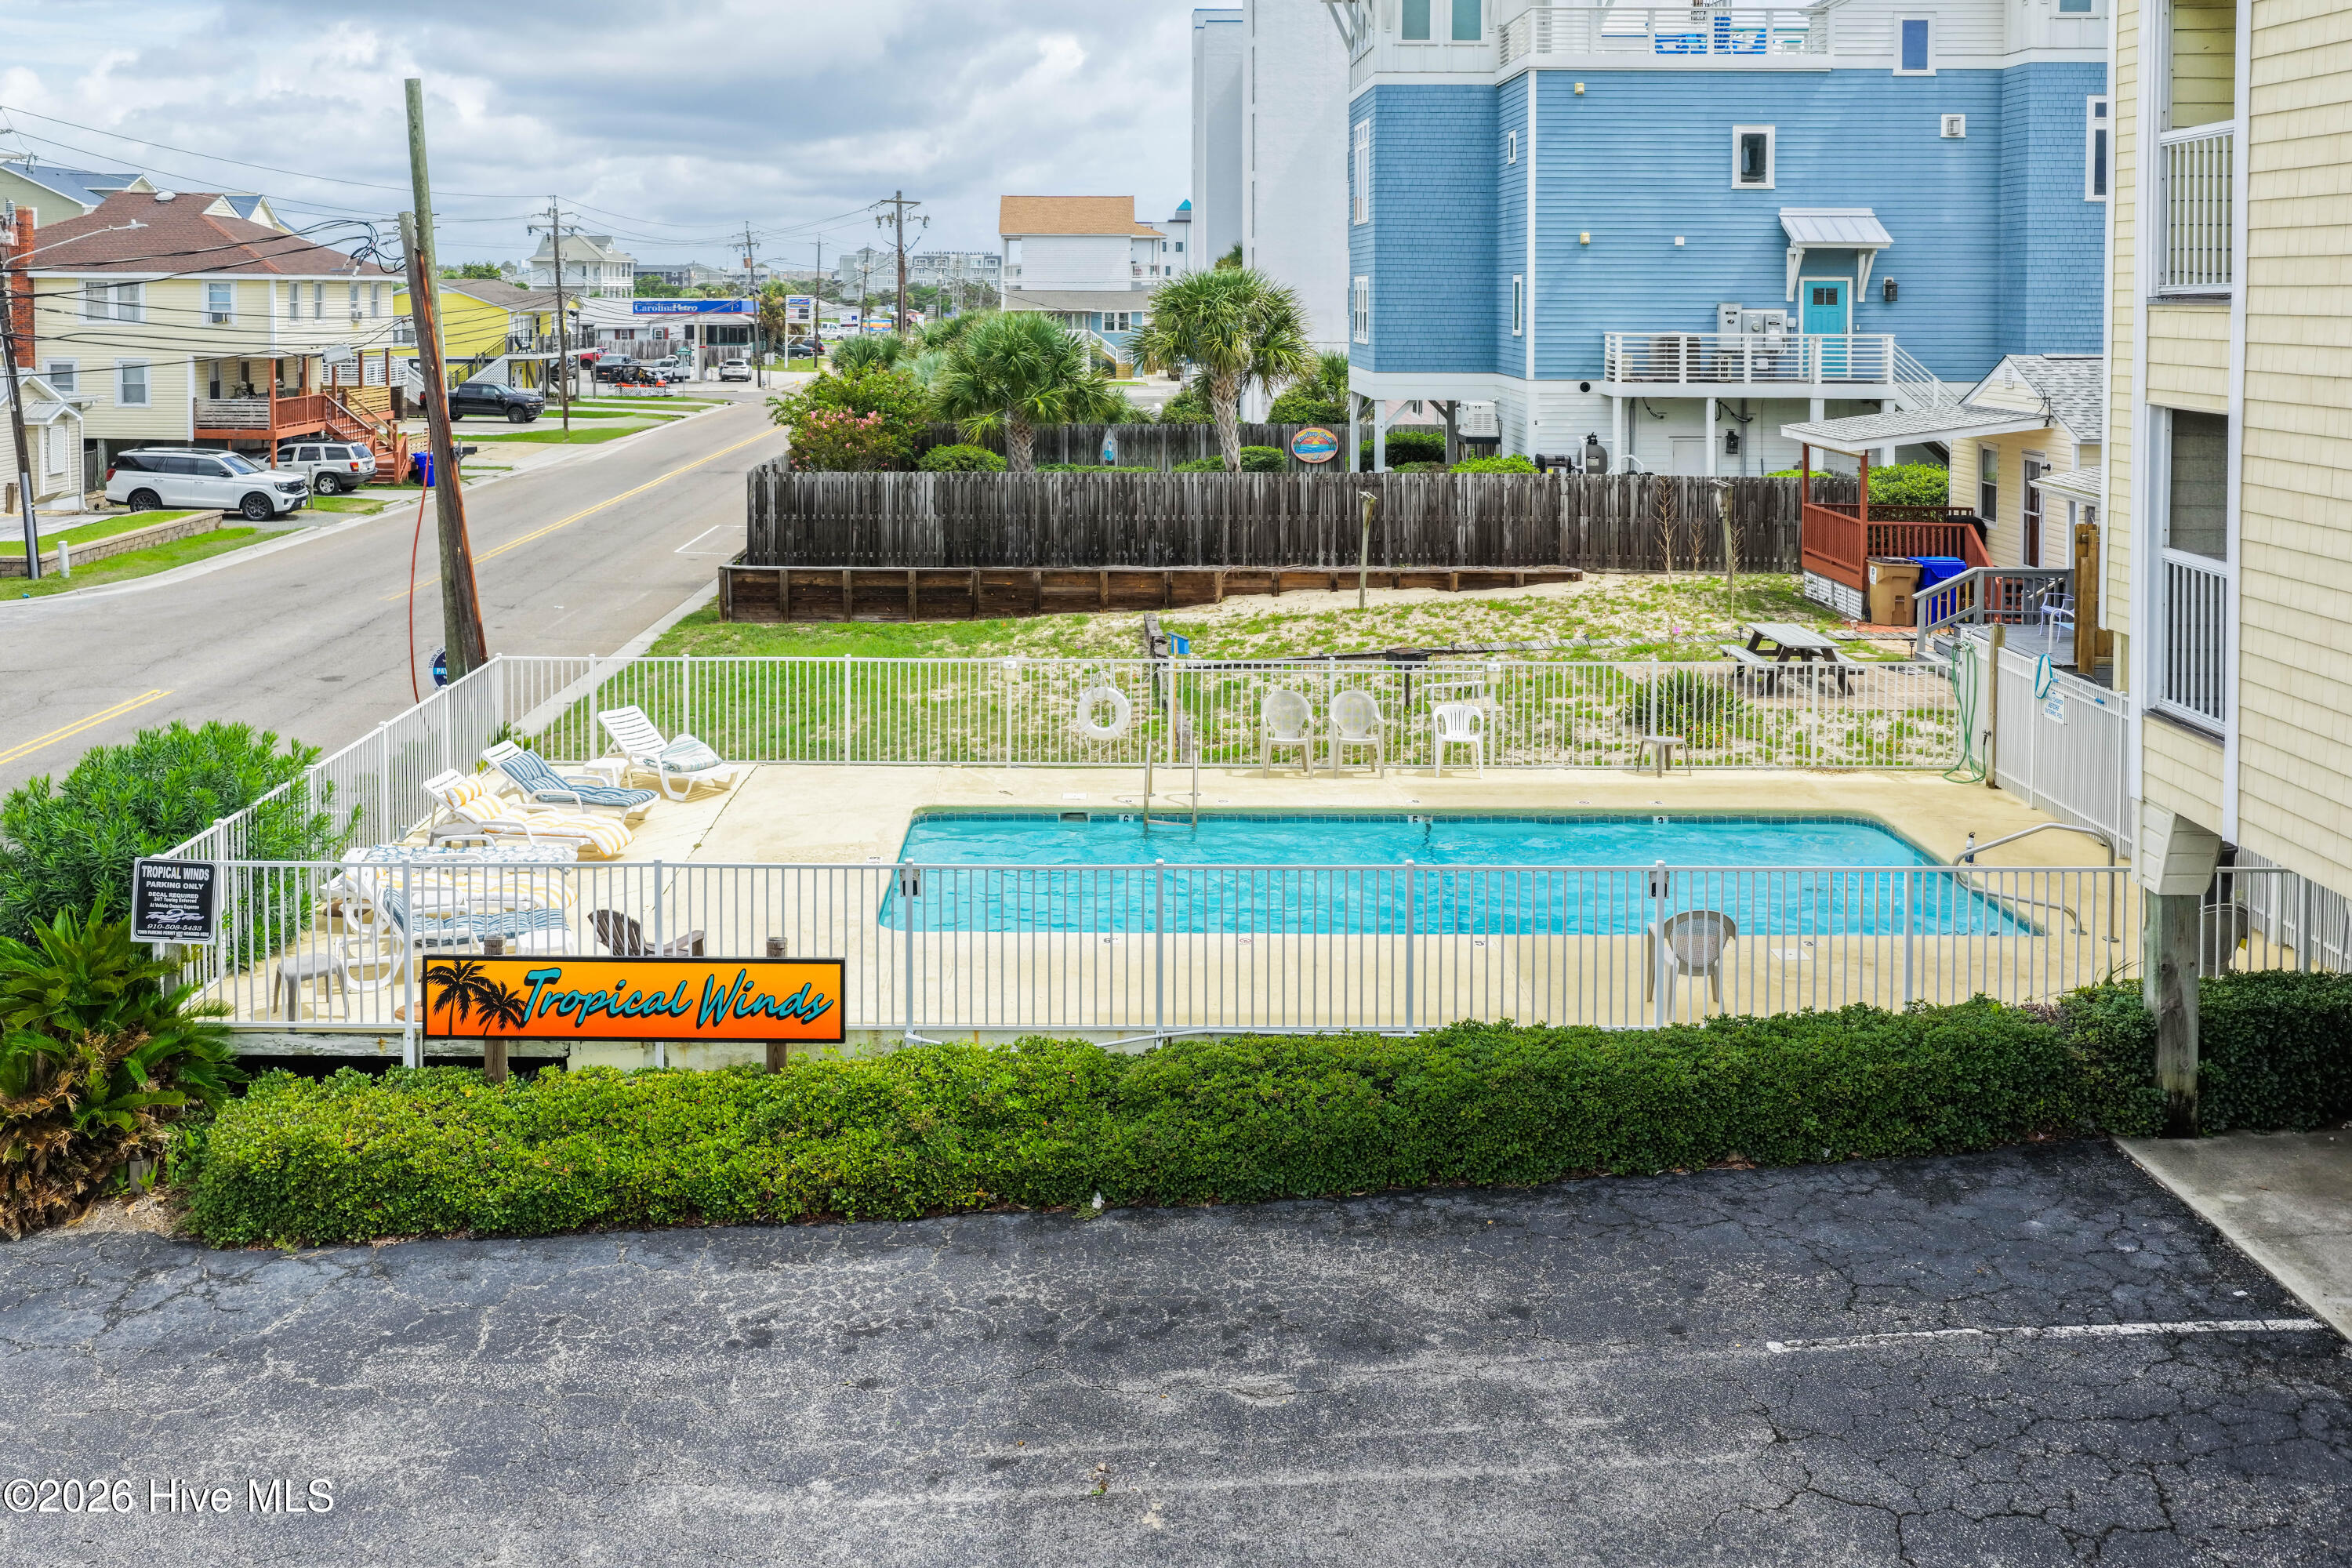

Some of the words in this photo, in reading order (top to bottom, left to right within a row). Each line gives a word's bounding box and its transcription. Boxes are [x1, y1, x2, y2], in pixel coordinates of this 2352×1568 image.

[428, 654, 437, 670] TOWN
[142, 866, 181, 879] TROPICAL
[183, 868, 209, 880] WINDS
[146, 880, 181, 889] PARKING
[521, 967, 694, 1028] Tropical
[695, 967, 834, 1029] Winds
